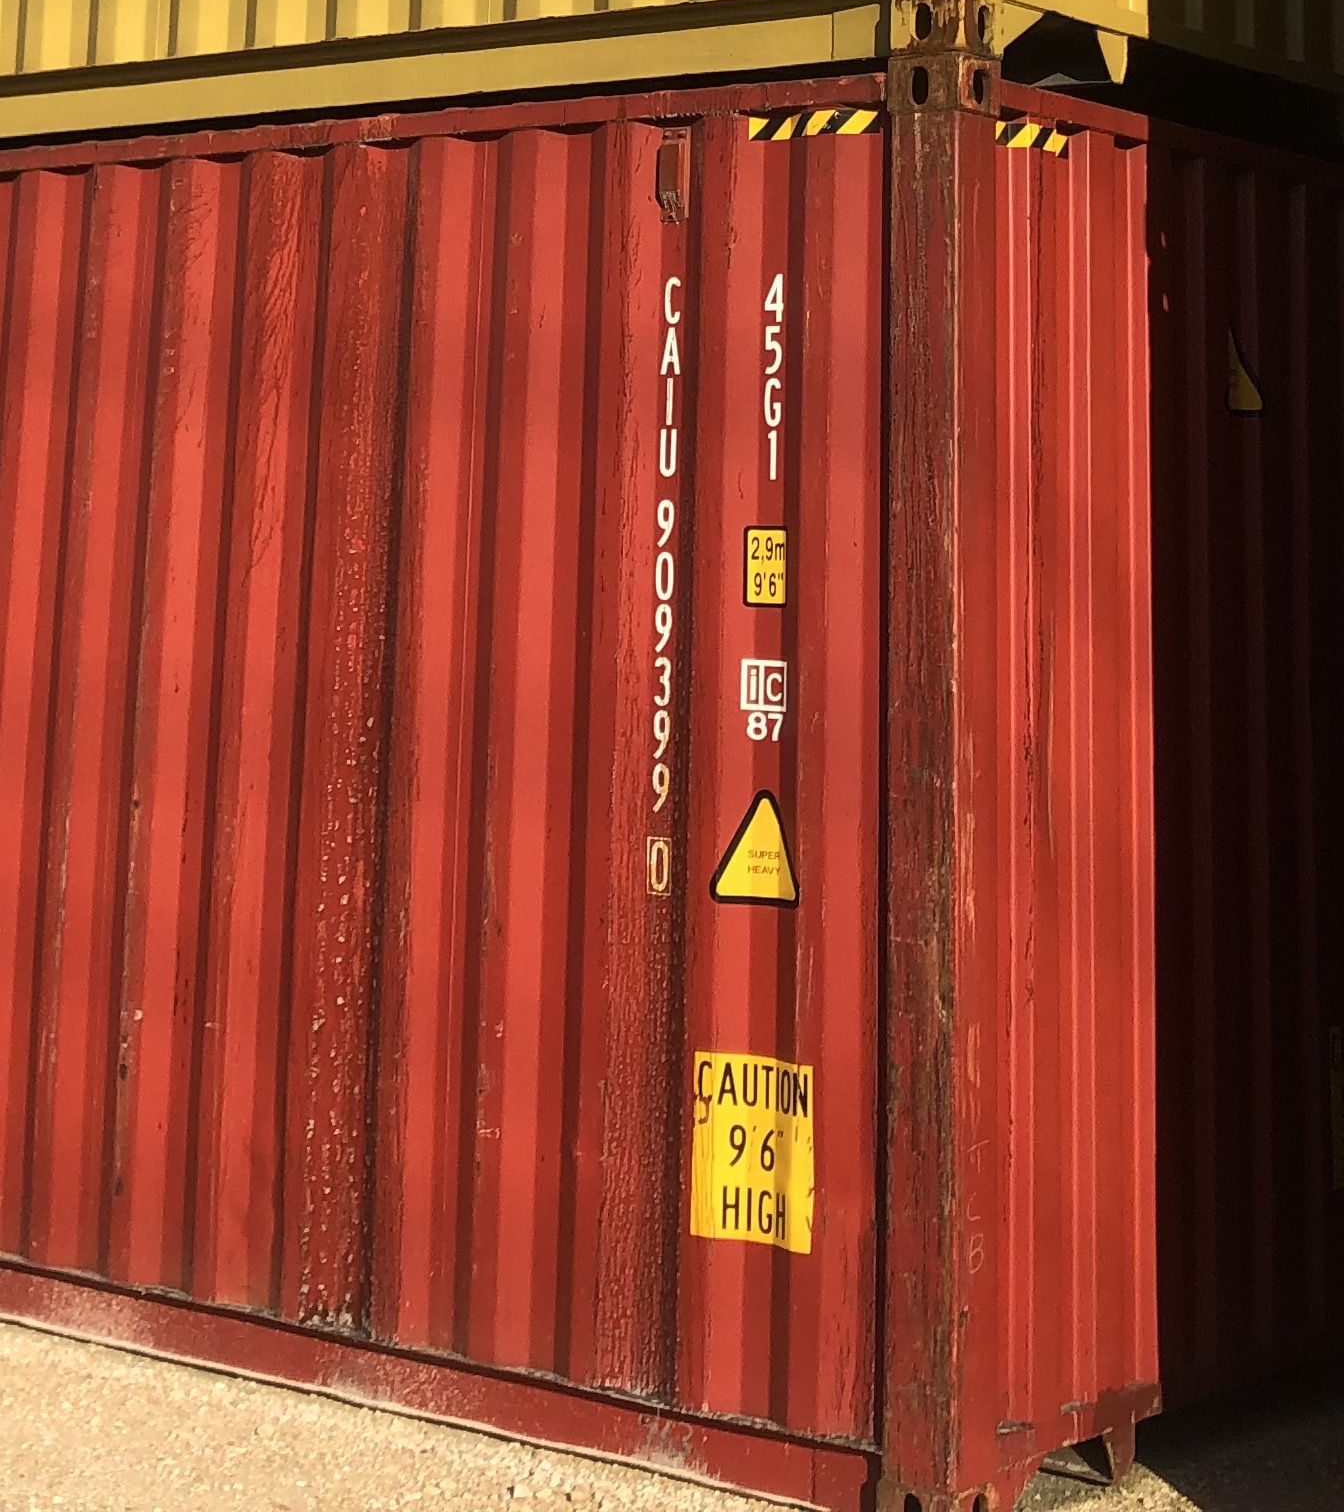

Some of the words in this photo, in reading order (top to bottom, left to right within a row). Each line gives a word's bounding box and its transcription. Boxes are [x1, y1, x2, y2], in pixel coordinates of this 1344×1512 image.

[659, 276, 682, 478] CAIU
[764, 273, 785, 481] 45G1
[652, 499, 675, 813] 909399
[746, 711, 784, 742] 87
[747, 849, 781, 861] SUPER
[747, 865, 781, 876] HEAVY
[697, 1060, 809, 1119] CAUTION
[721, 1184, 787, 1241] HIGH
